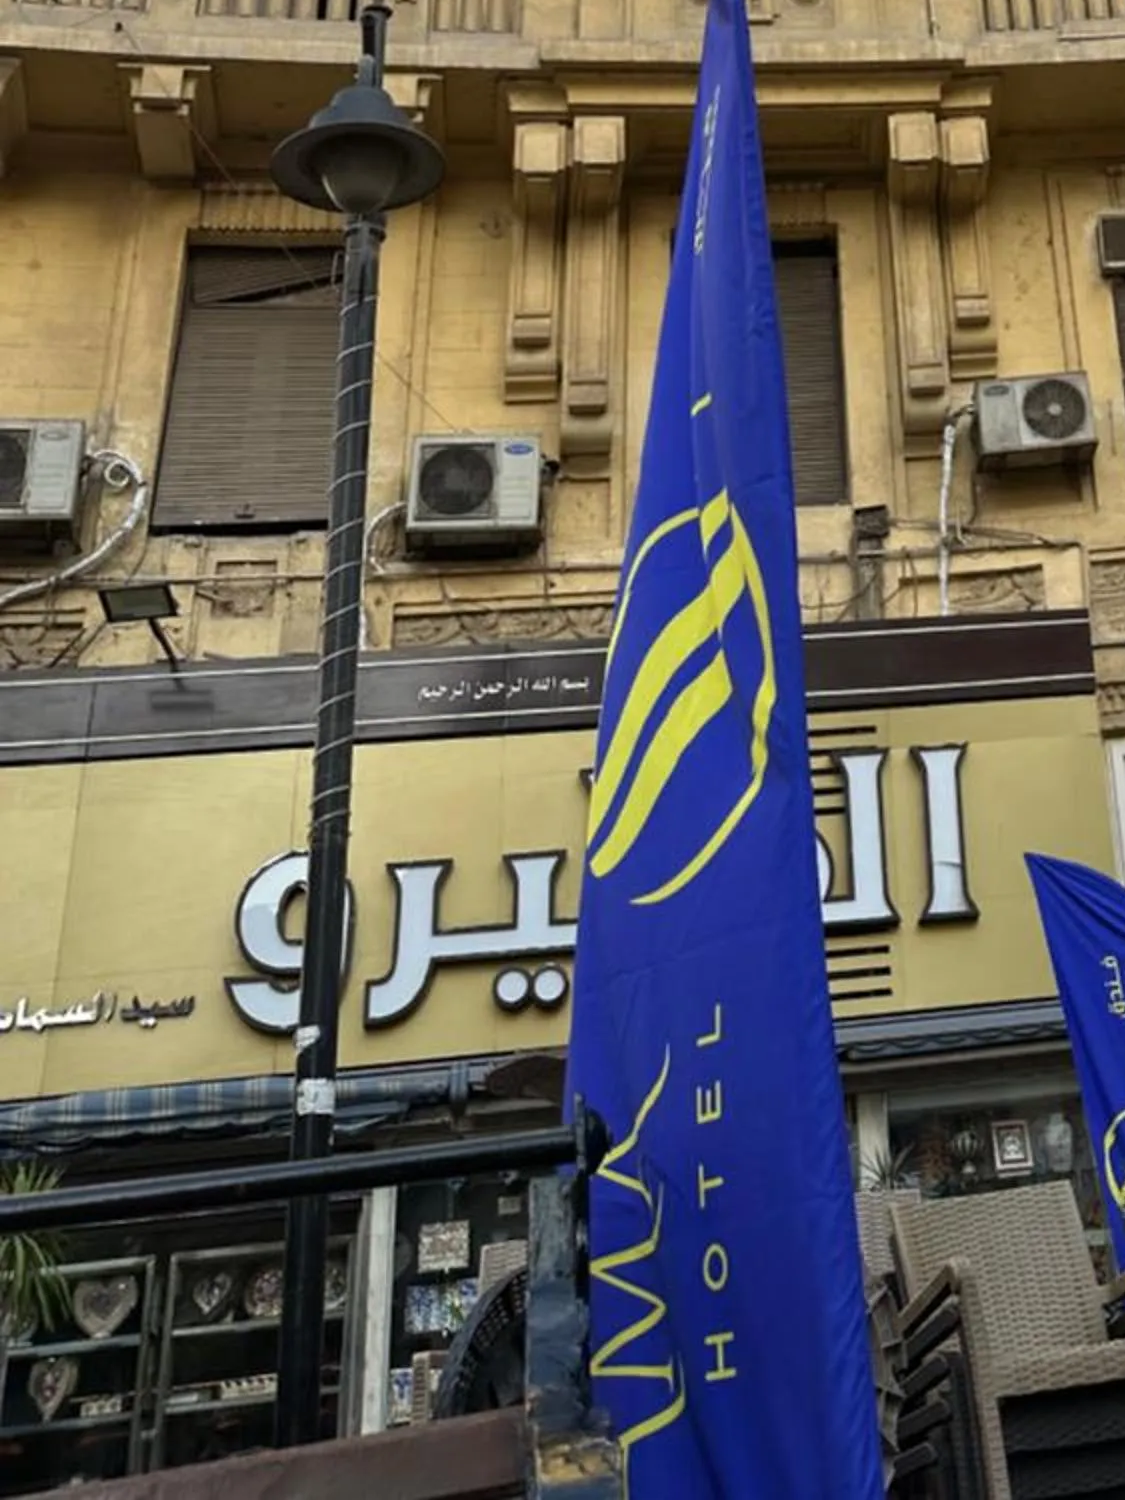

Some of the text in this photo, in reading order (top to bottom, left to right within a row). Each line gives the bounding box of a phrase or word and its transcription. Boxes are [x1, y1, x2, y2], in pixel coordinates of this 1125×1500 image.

[417, 675, 591, 704] بسم الله الرحمن الرحيم
[120, 995, 196, 1030] سيد
[589, 1042, 685, 1500] AMA
[696, 1003, 737, 1382] HOTEL
